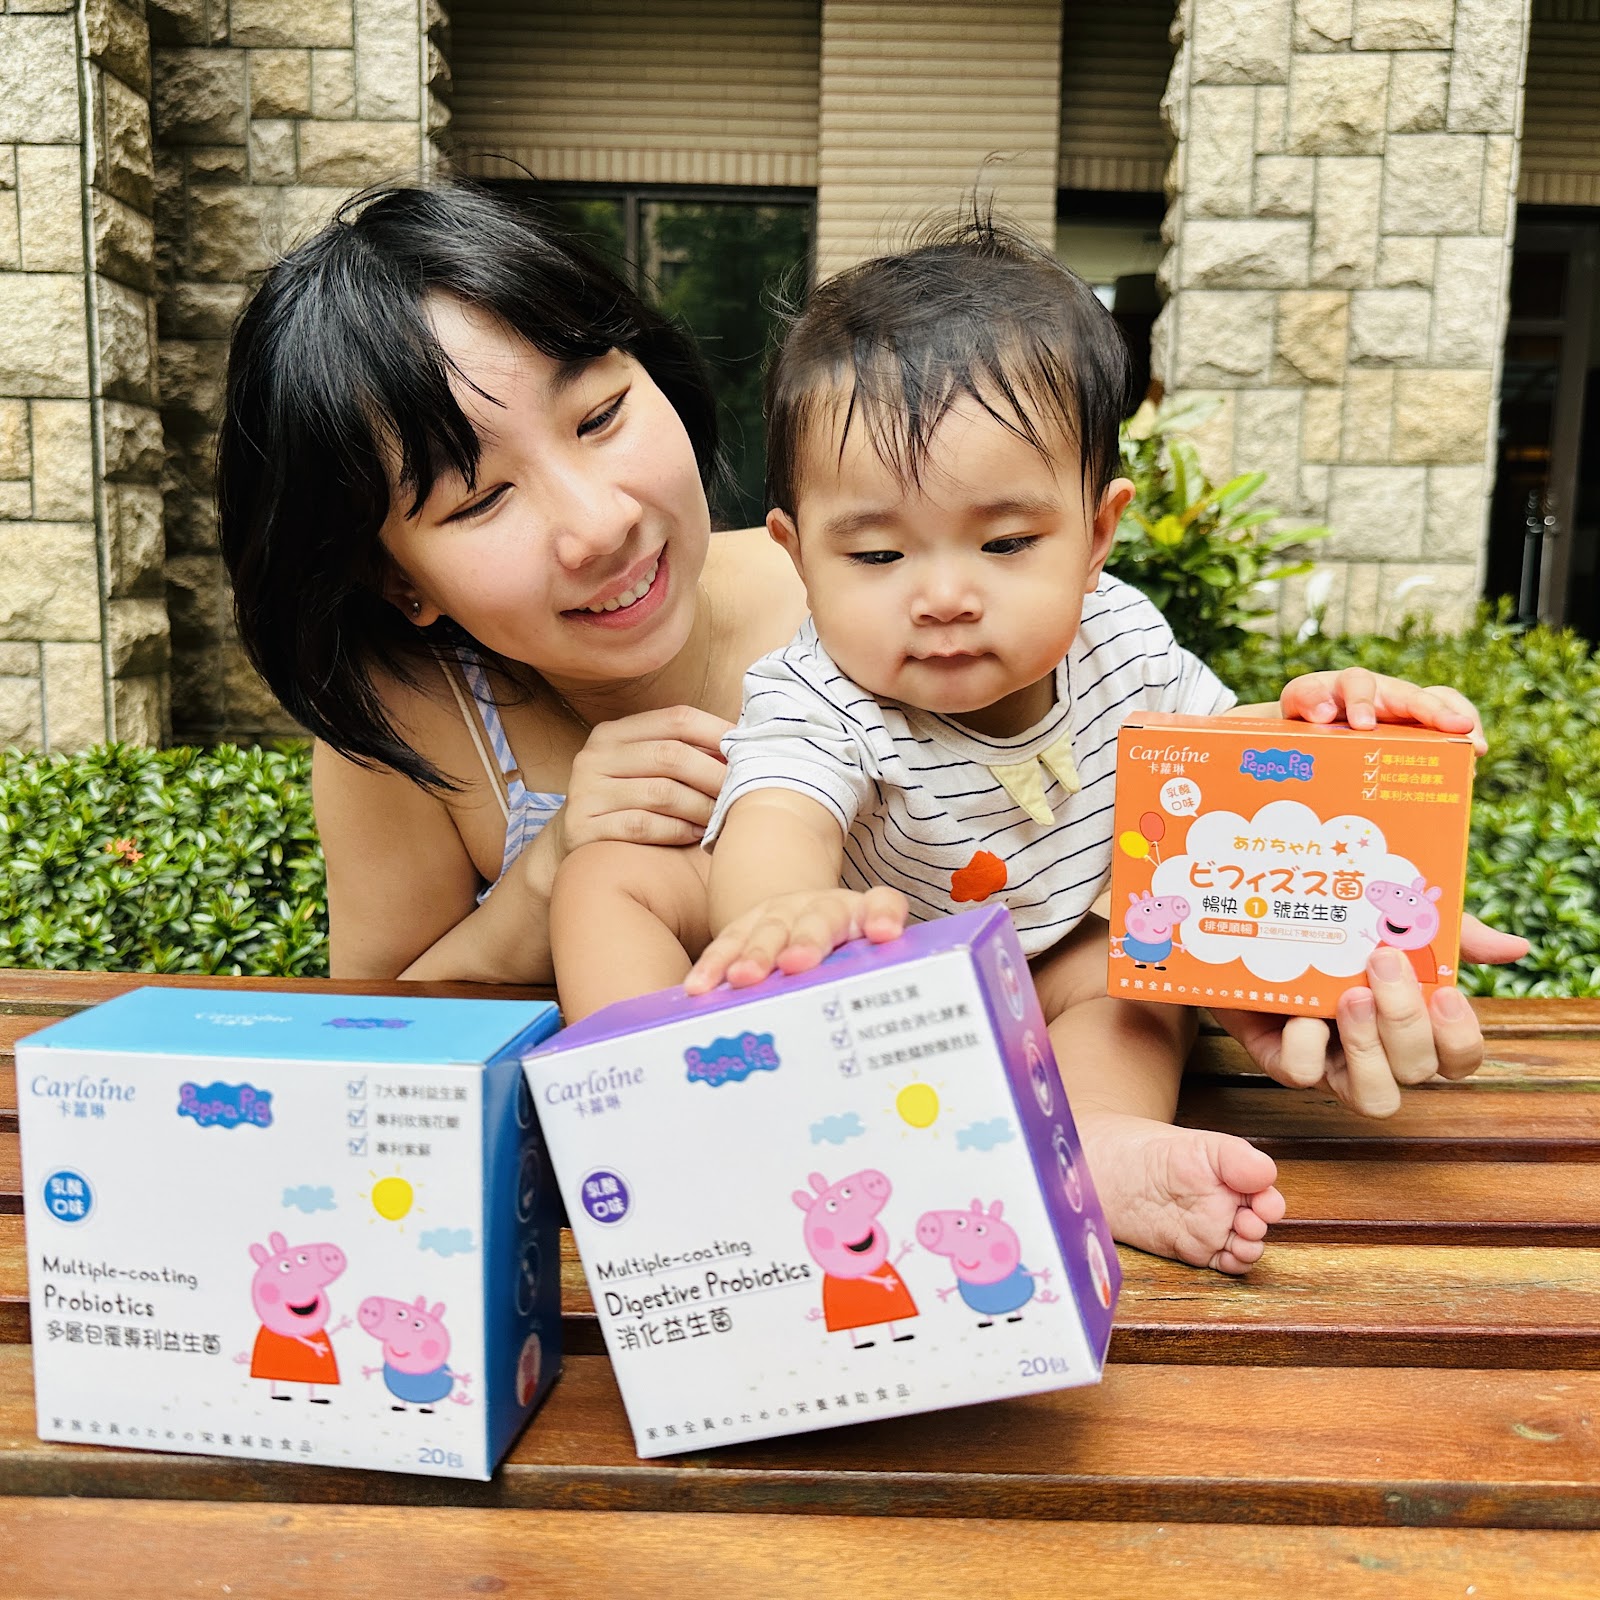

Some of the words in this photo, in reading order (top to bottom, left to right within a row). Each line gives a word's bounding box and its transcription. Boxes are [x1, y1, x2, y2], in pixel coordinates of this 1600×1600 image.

[1243, 751, 1287, 778] Peppa
[1288, 753, 1314, 780] Pig
[1166, 783, 1192, 799] 乳酸
[1171, 798, 1196, 811] 口味
[1233, 836, 1322, 856] あかちゃん
[1189, 860, 1366, 901] ビフィズス菌
[686, 1048, 748, 1084] Peppa
[742, 1034, 779, 1067] Pig
[180, 1084, 239, 1124] Peppa
[240, 1087, 272, 1124] Pig
[42, 1254, 198, 1290] Multiple-coating
[596, 1240, 753, 1281] Multiple-coating
[44, 1283, 155, 1317] Probiotics
[605, 1283, 703, 1319] Digestive
[705, 1261, 811, 1298] Probiotics
[616, 1306, 734, 1351] 消化益生菌
